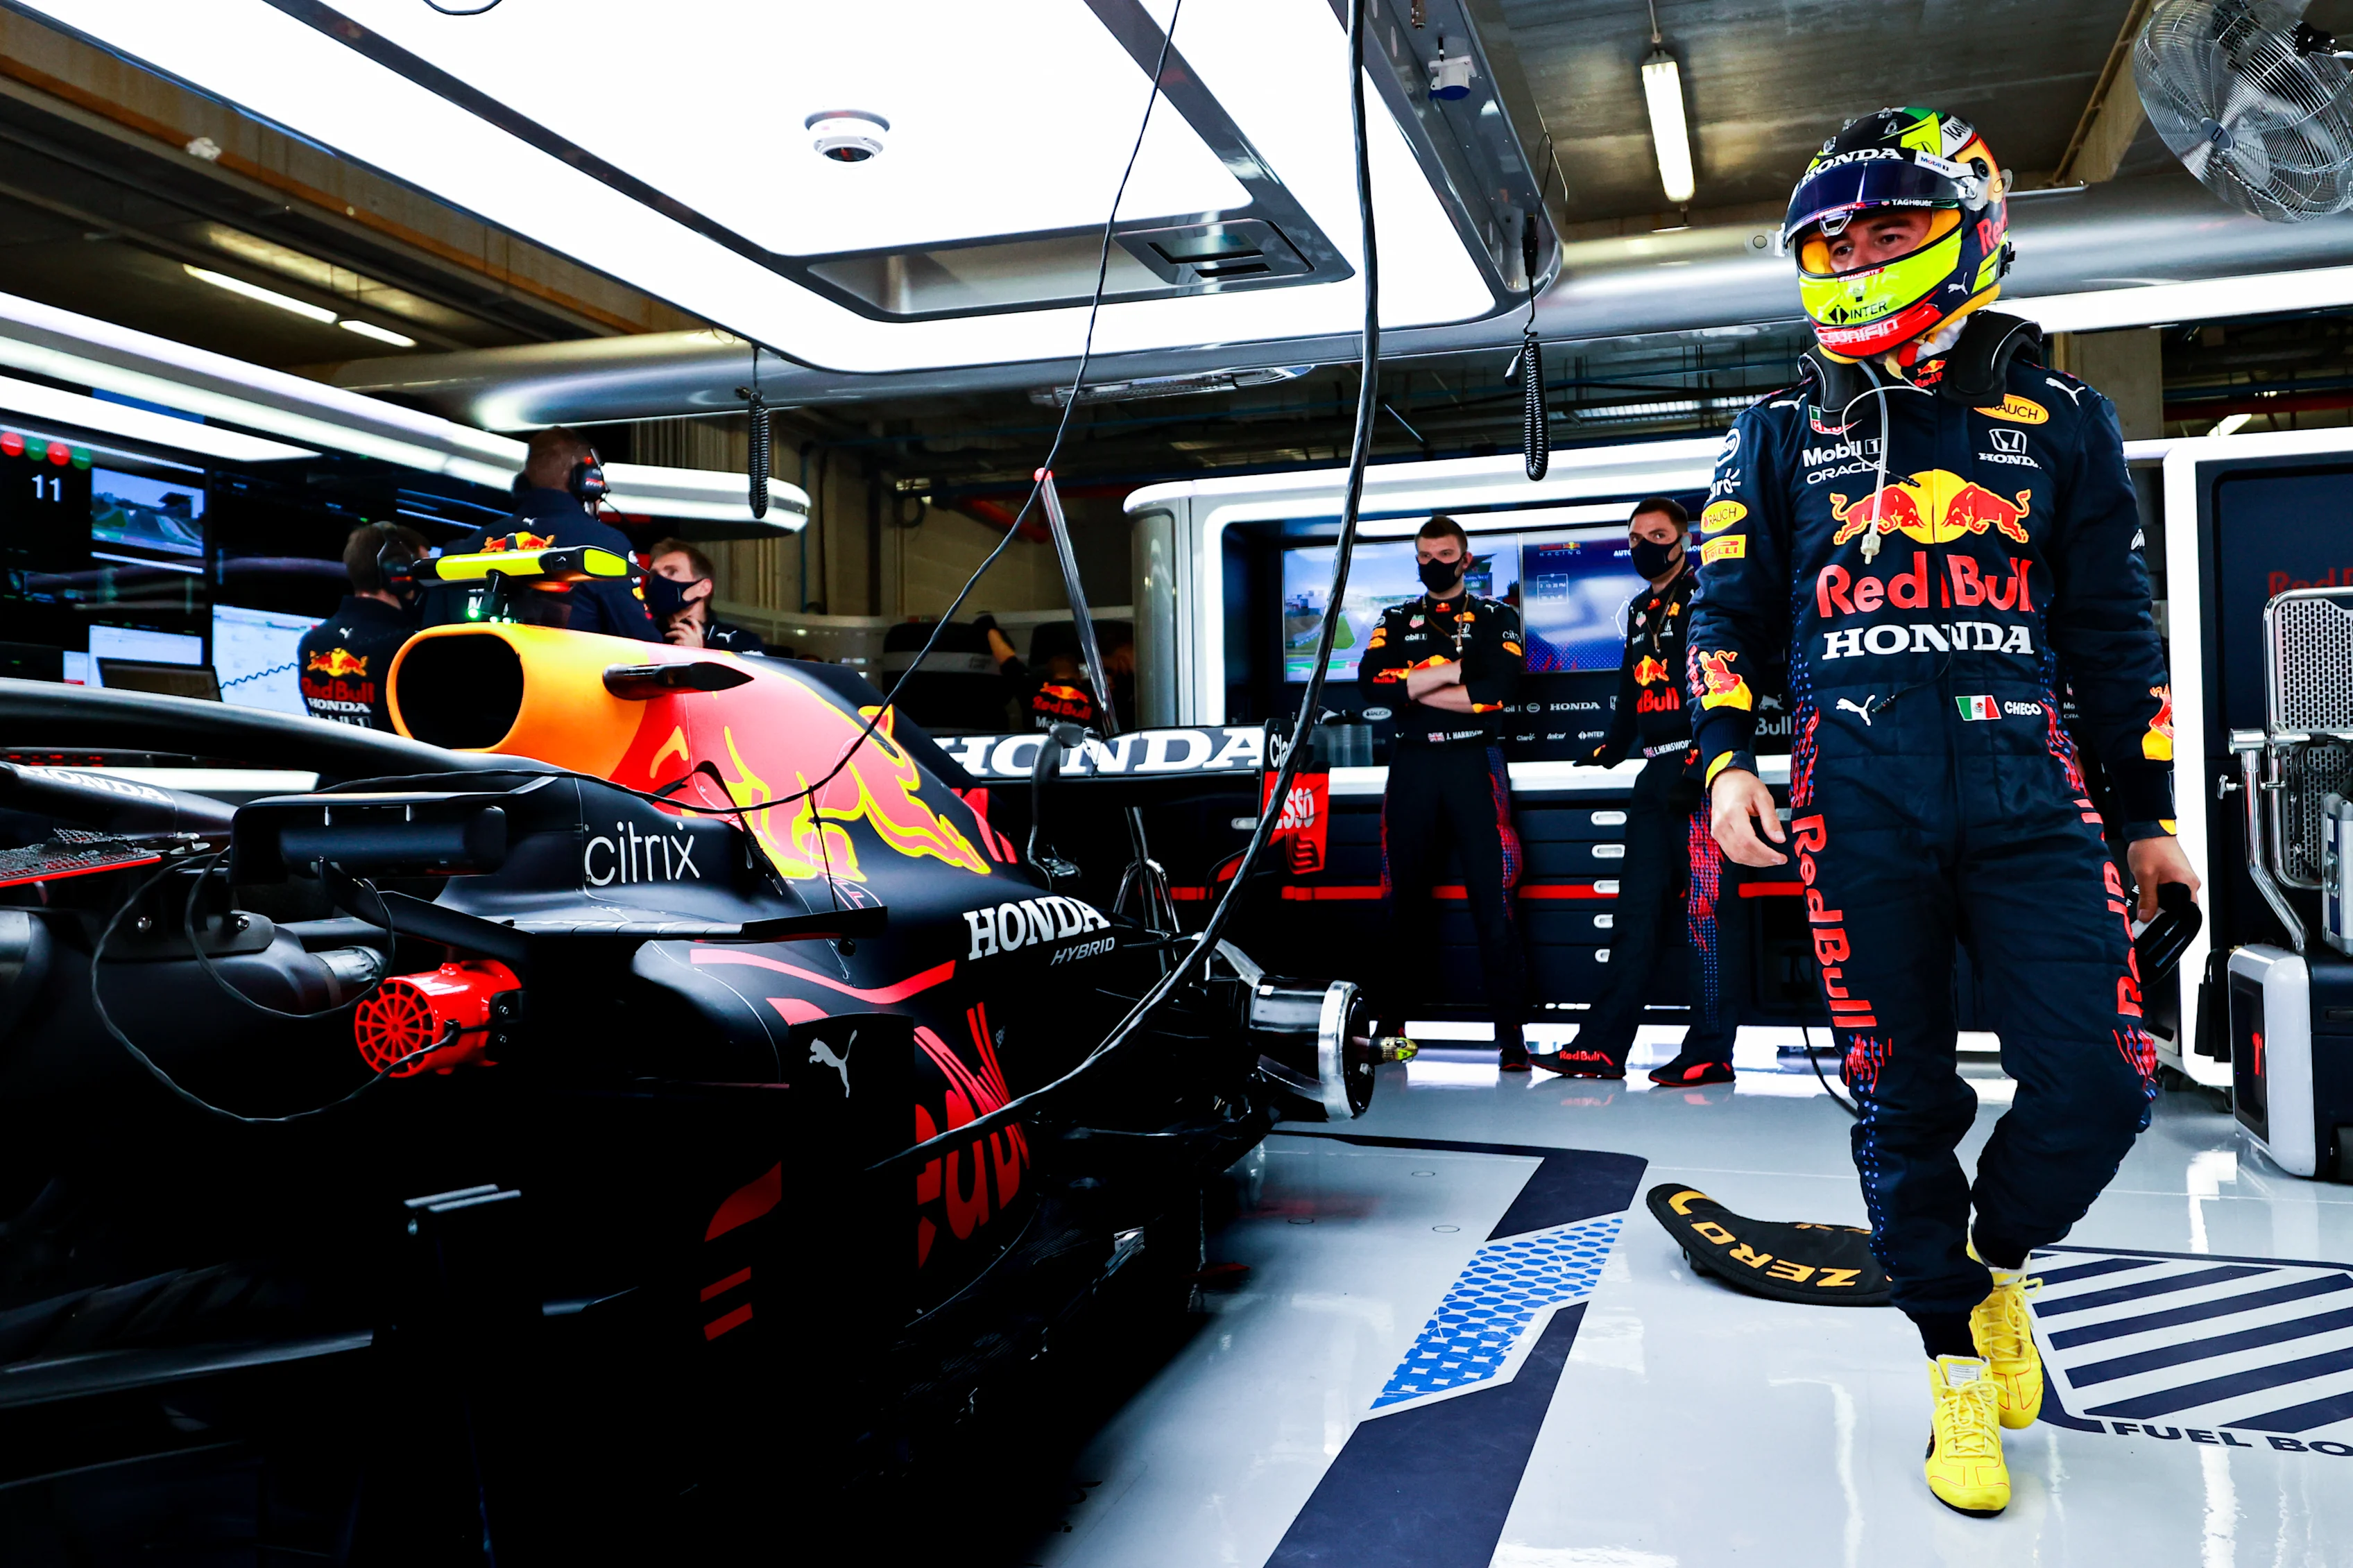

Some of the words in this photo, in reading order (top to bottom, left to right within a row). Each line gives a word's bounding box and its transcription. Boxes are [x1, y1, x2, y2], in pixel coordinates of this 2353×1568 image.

[1799, 148, 1903, 189] HONDA
[1921, 156, 1942, 168] Mobil
[1976, 196, 2008, 256] Red
[1850, 302, 1888, 320] INTER
[1803, 440, 1862, 467] Mobil
[1806, 460, 1886, 485] ORACLE
[32, 474, 61, 502] 11
[1708, 507, 1737, 525] RAUCH
[1816, 551, 1930, 618] Red
[1942, 554, 2036, 613] Bull
[1822, 621, 2035, 661] HONDA
[307, 697, 371, 713] HONDA
[335, 680, 375, 703] Bull
[1643, 687, 1679, 712] Bull
[1550, 702, 1600, 711] HONDA
[2004, 700, 2042, 716] CHECO
[1755, 715, 1792, 736] Bull
[932, 727, 1265, 777] HONDA
[1269, 734, 1292, 768] Cla
[18, 764, 173, 802] HONDA
[584, 820, 701, 887] citrix
[1791, 813, 1843, 923] Red
[962, 895, 1111, 961] HONDA
[1050, 936, 1115, 966] HYBRID
[1813, 928, 1878, 1027] Bull
[1559, 1050, 1580, 1060] Red
[1581, 1051, 1600, 1061] Bull
[1691, 1221, 1863, 1287] ZERO
[2111, 1421, 2253, 1448] FUEL
